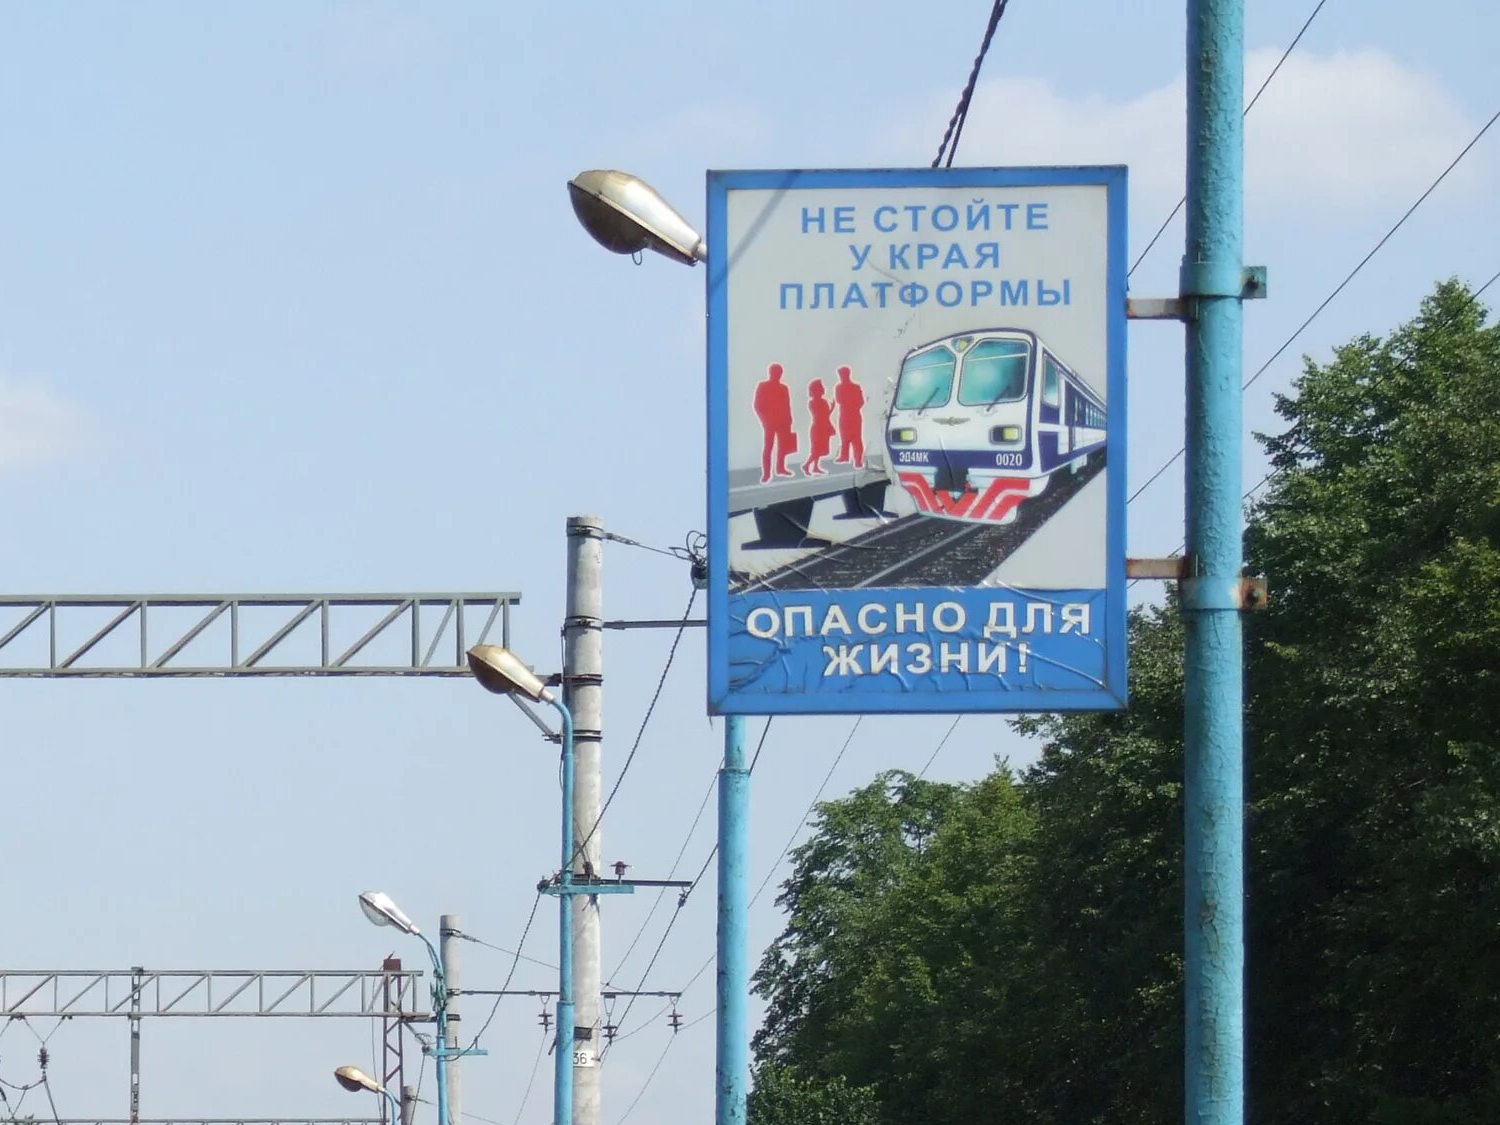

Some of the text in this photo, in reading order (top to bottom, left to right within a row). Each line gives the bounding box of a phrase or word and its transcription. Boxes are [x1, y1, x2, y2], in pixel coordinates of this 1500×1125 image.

[801, 198, 1050, 234] НЕ СТОЙТЕ
[849, 242, 1001, 272] У КРАЯ
[779, 278, 1071, 310] ПЛАТФОРМЫ
[898, 450, 930, 463] ЭД4МК
[995, 453, 1023, 466] 0020
[745, 602, 1091, 639] ОПАСНО ДЛЯ
[822, 641, 1030, 677] ЖИЗНИ!
